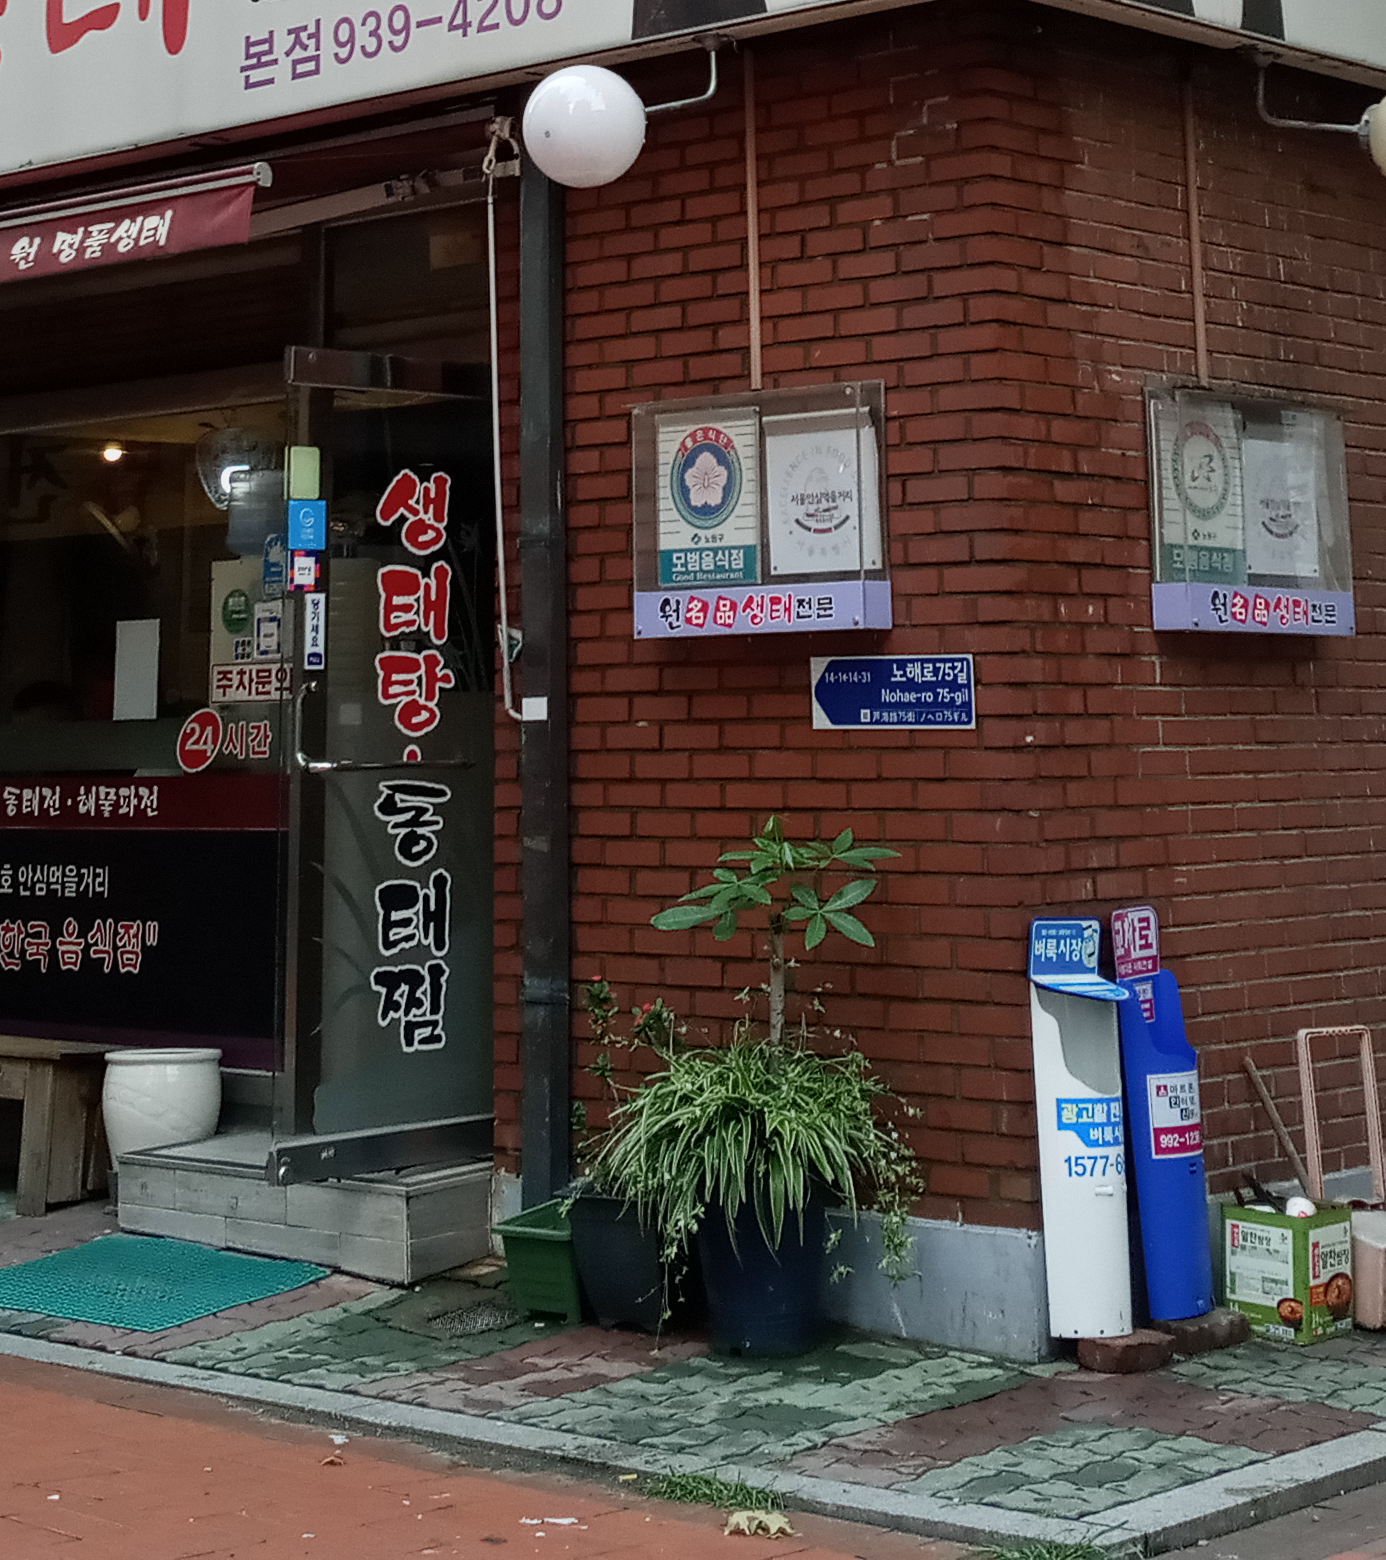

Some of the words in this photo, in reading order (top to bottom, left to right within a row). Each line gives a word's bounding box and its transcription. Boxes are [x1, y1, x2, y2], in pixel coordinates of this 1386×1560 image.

[239, 23, 323, 92] 본점
[10, 236, 41, 270] 원
[672, 548, 745, 573] 모범음식점
[672, 572, 694, 582] Good
[696, 570, 744, 582] Restaurant
[376, 469, 453, 737] 생태탕
[660, 596, 682, 629] 원
[741, 594, 793, 626] 생태
[795, 597, 835, 620] 전문
[1211, 591, 1229, 623] 원
[1273, 596, 1309, 627] 생태
[1311, 603, 1337, 624] 전문
[215, 664, 293, 697] 주차문의
[891, 660, 967, 684] 노해로75길
[881, 688, 934, 703] Nohae-ro
[937, 688, 969, 705] 75-gil
[3, 785, 61, 817] 동태전
[77, 785, 158, 818] 해물파전
[18, 865, 110, 899] 안심먹을거리
[371, 780, 452, 1052] 동태찜
[1034, 937, 1083, 962] 벼룩시장
[1090, 1126, 1122, 1145] 벼룩시
